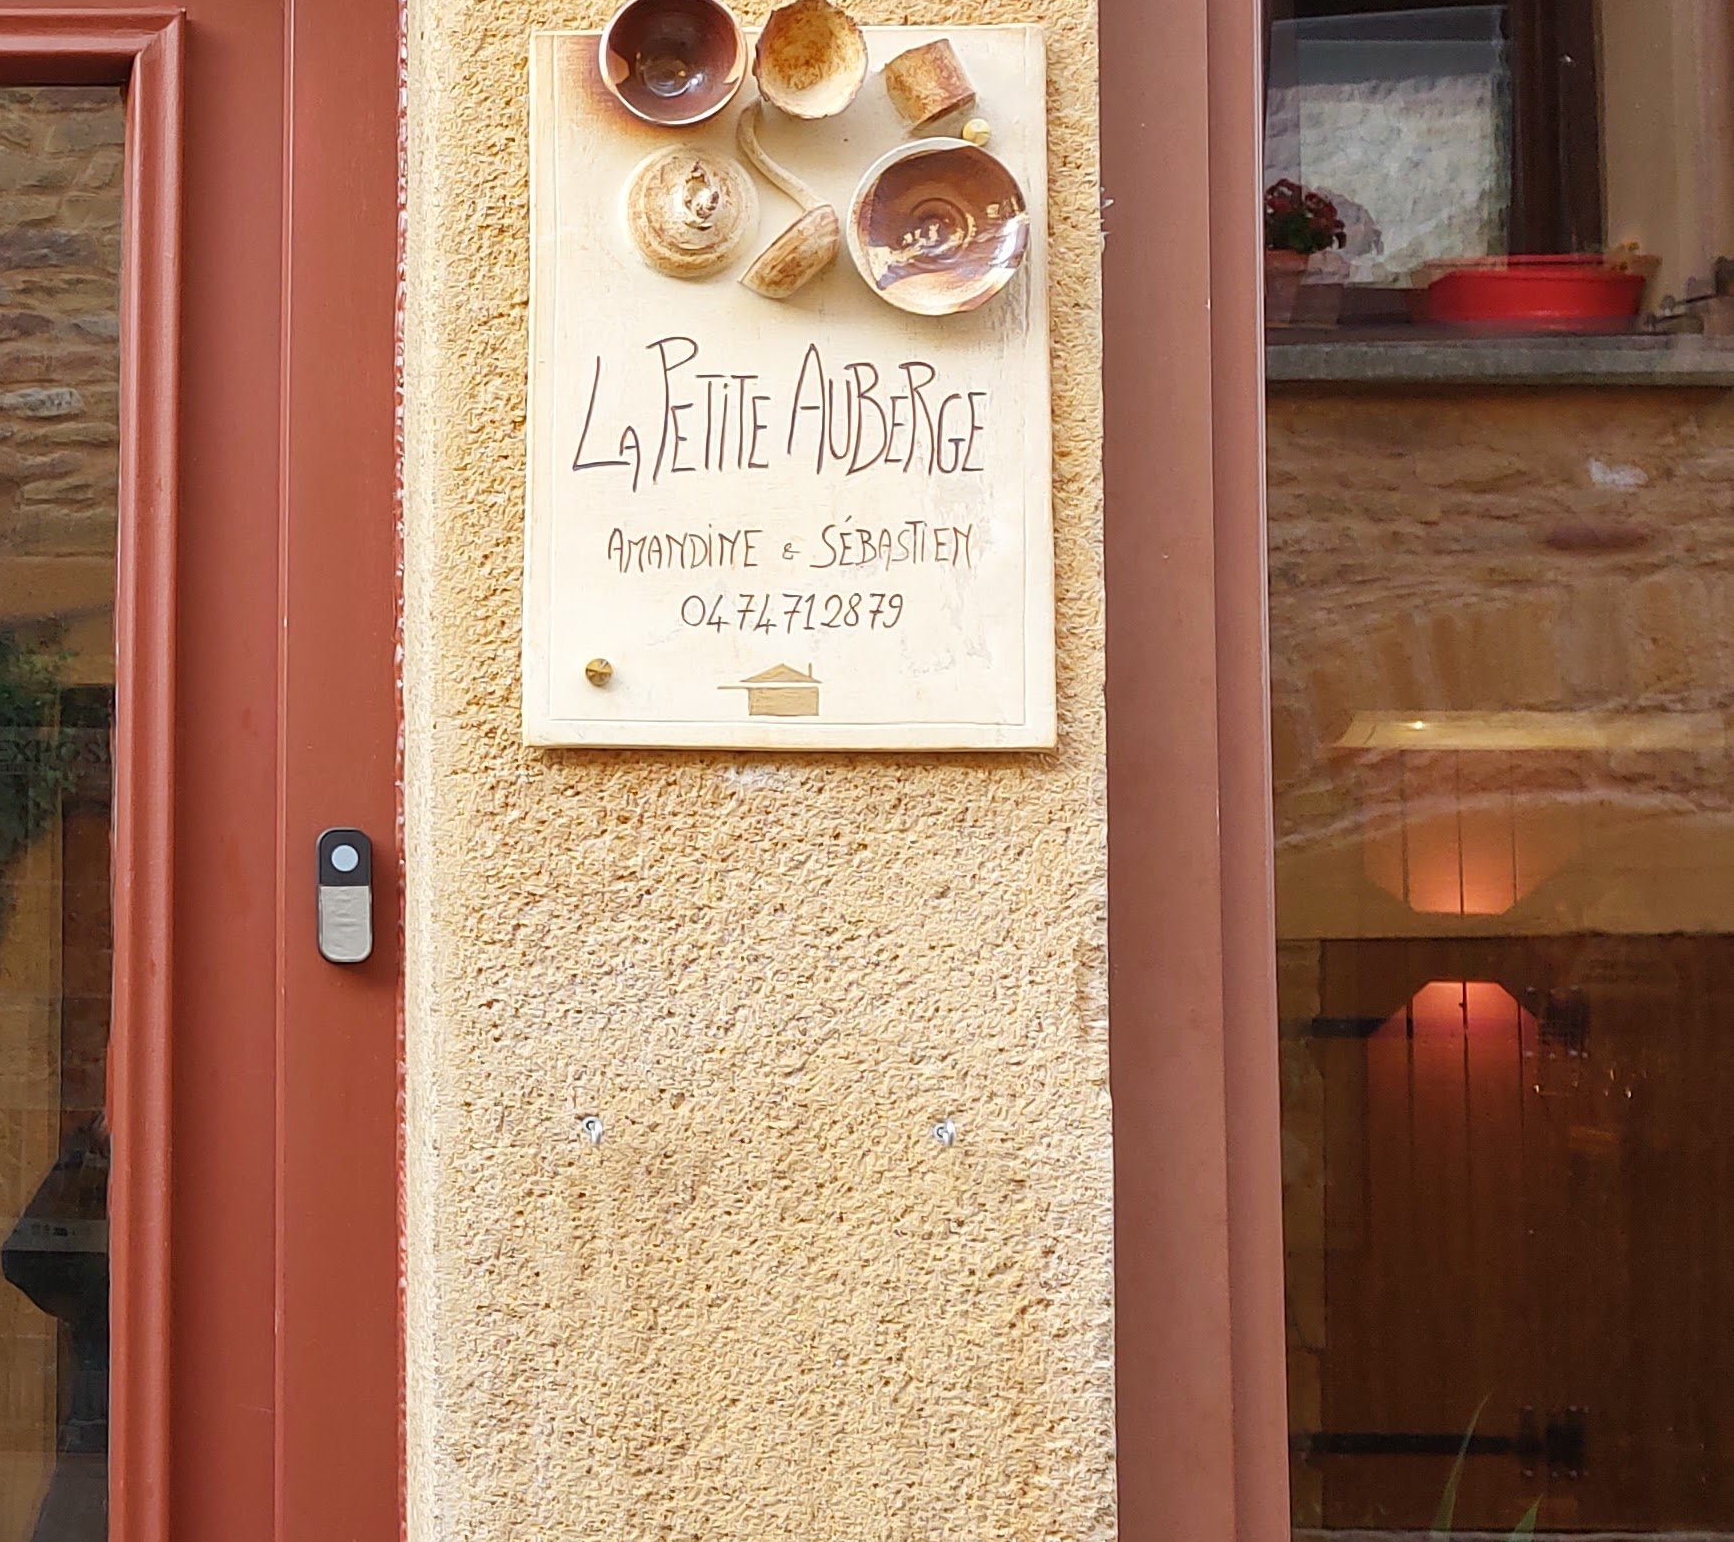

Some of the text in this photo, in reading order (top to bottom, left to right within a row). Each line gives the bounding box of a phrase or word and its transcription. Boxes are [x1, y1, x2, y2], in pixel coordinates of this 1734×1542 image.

[572, 355, 641, 492] LA
[786, 343, 986, 477] AUBERGE
[680, 592, 904, 634] 0474712879
